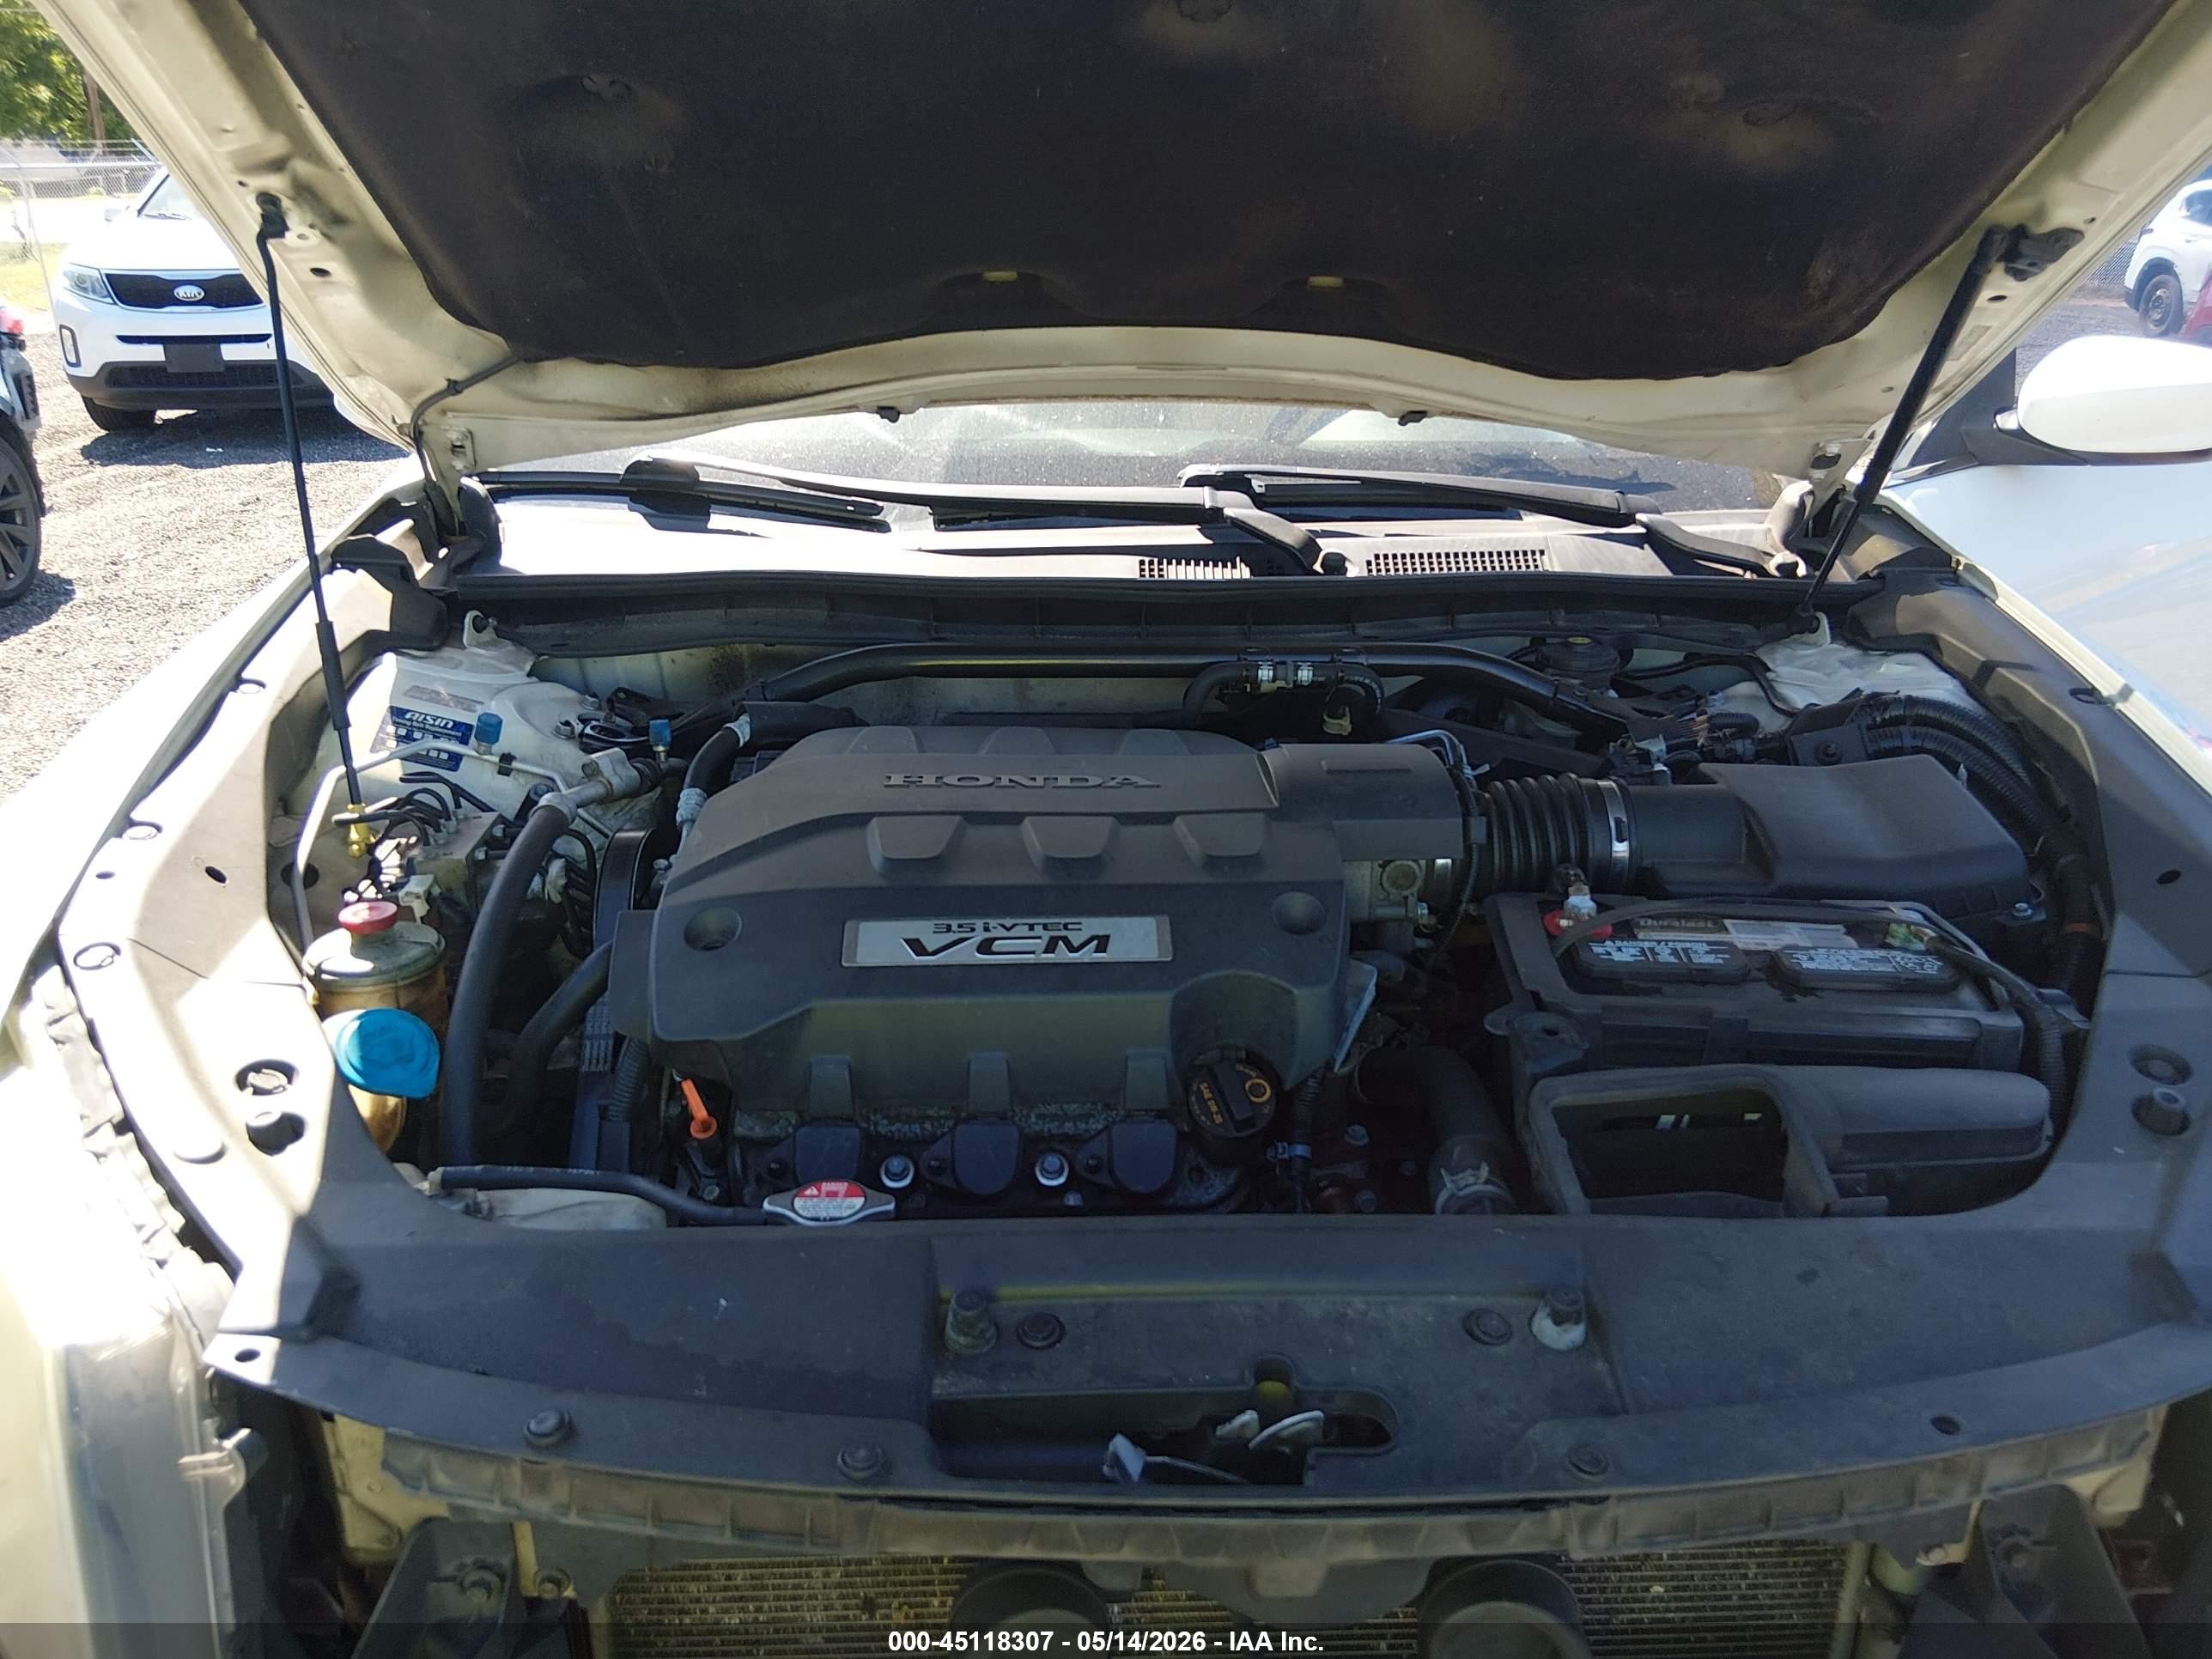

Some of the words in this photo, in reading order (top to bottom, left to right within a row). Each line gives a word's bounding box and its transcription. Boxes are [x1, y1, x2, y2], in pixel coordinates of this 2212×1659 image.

[175, 287, 203, 300] KIA
[884, 775, 1161, 788] HONDA
[900, 933, 1111, 960] VCM
